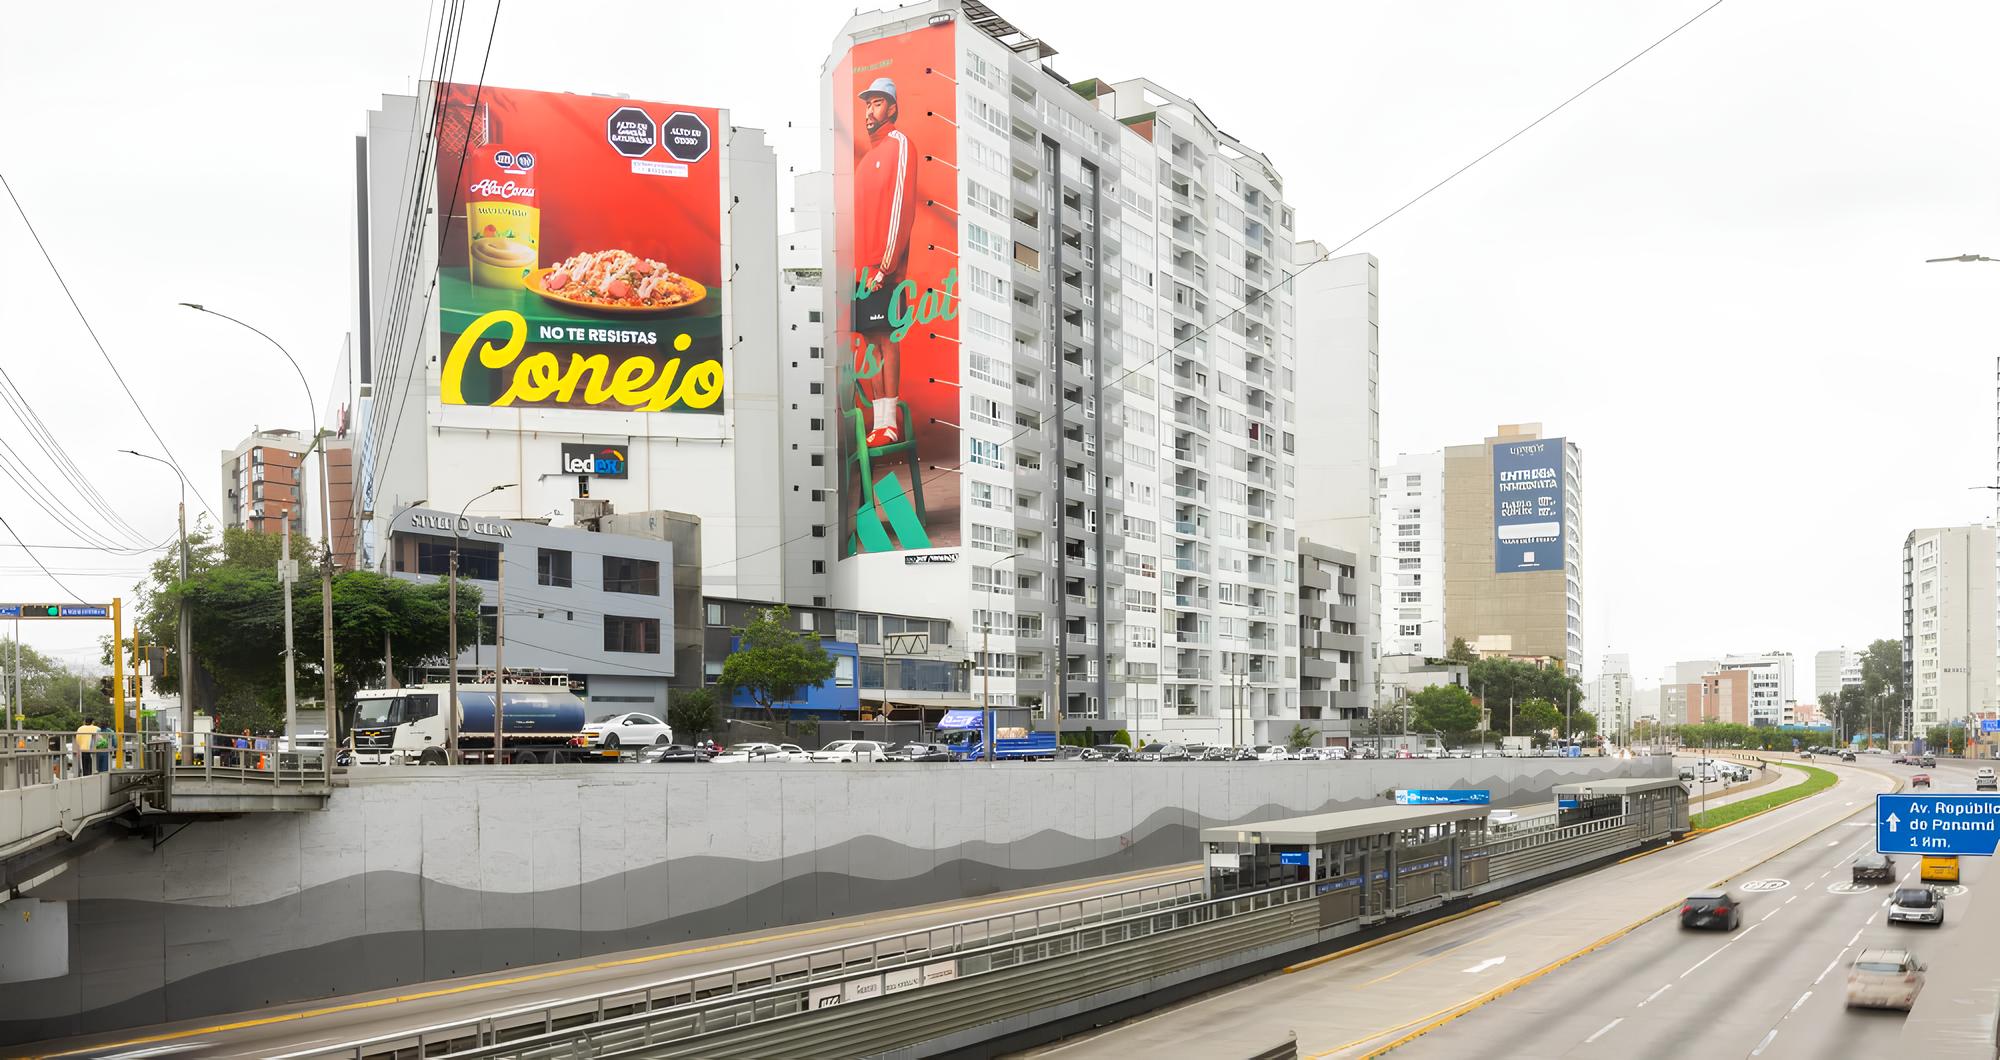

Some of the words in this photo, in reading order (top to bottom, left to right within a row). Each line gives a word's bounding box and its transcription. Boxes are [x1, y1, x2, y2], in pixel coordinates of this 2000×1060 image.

[888, 268, 957, 343] Got
[540, 325, 564, 340] NO
[566, 328, 585, 340] TE
[588, 329, 657, 345] RESISTAS
[441, 310, 724, 411] Conejo
[1909, 802, 1931, 814] Av.
[1910, 837, 1918, 847] 1
